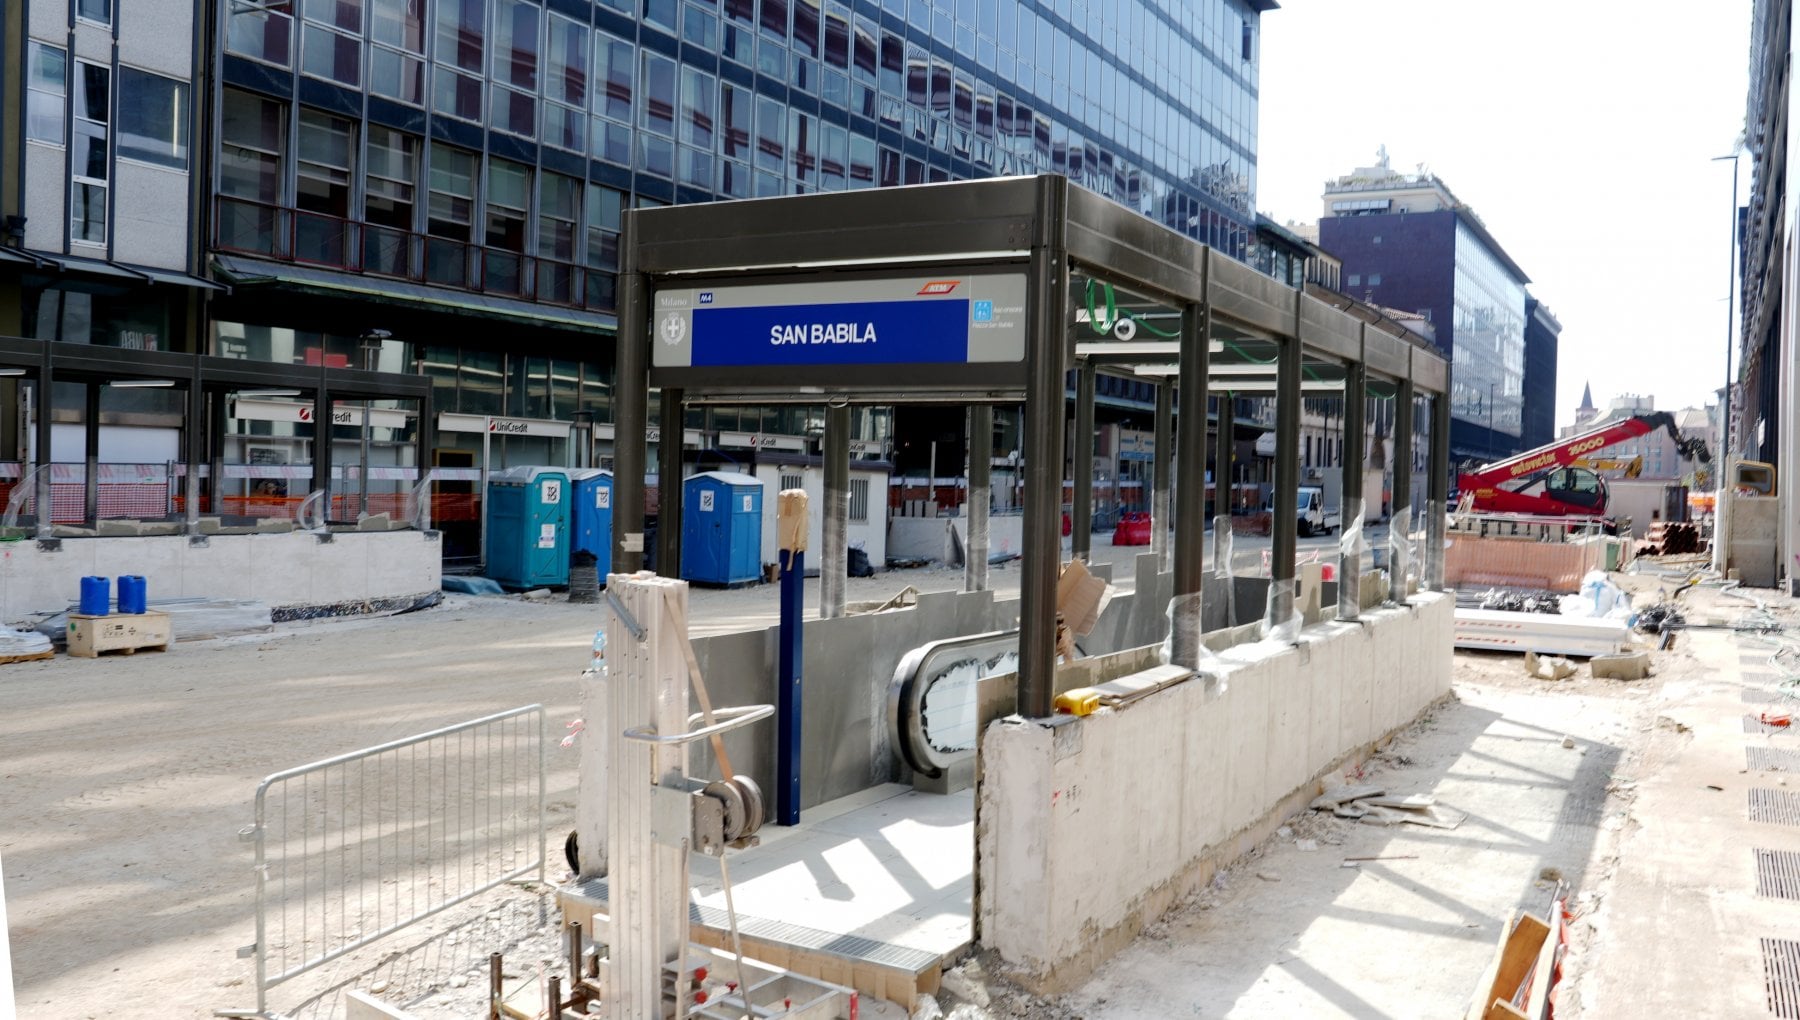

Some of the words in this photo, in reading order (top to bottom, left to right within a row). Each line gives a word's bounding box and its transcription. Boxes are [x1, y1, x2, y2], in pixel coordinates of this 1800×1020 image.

[929, 284, 948, 293] ATM
[770, 324, 807, 345] SAN
[811, 322, 877, 344] BABILA
[496, 421, 528, 433] UniCredit
